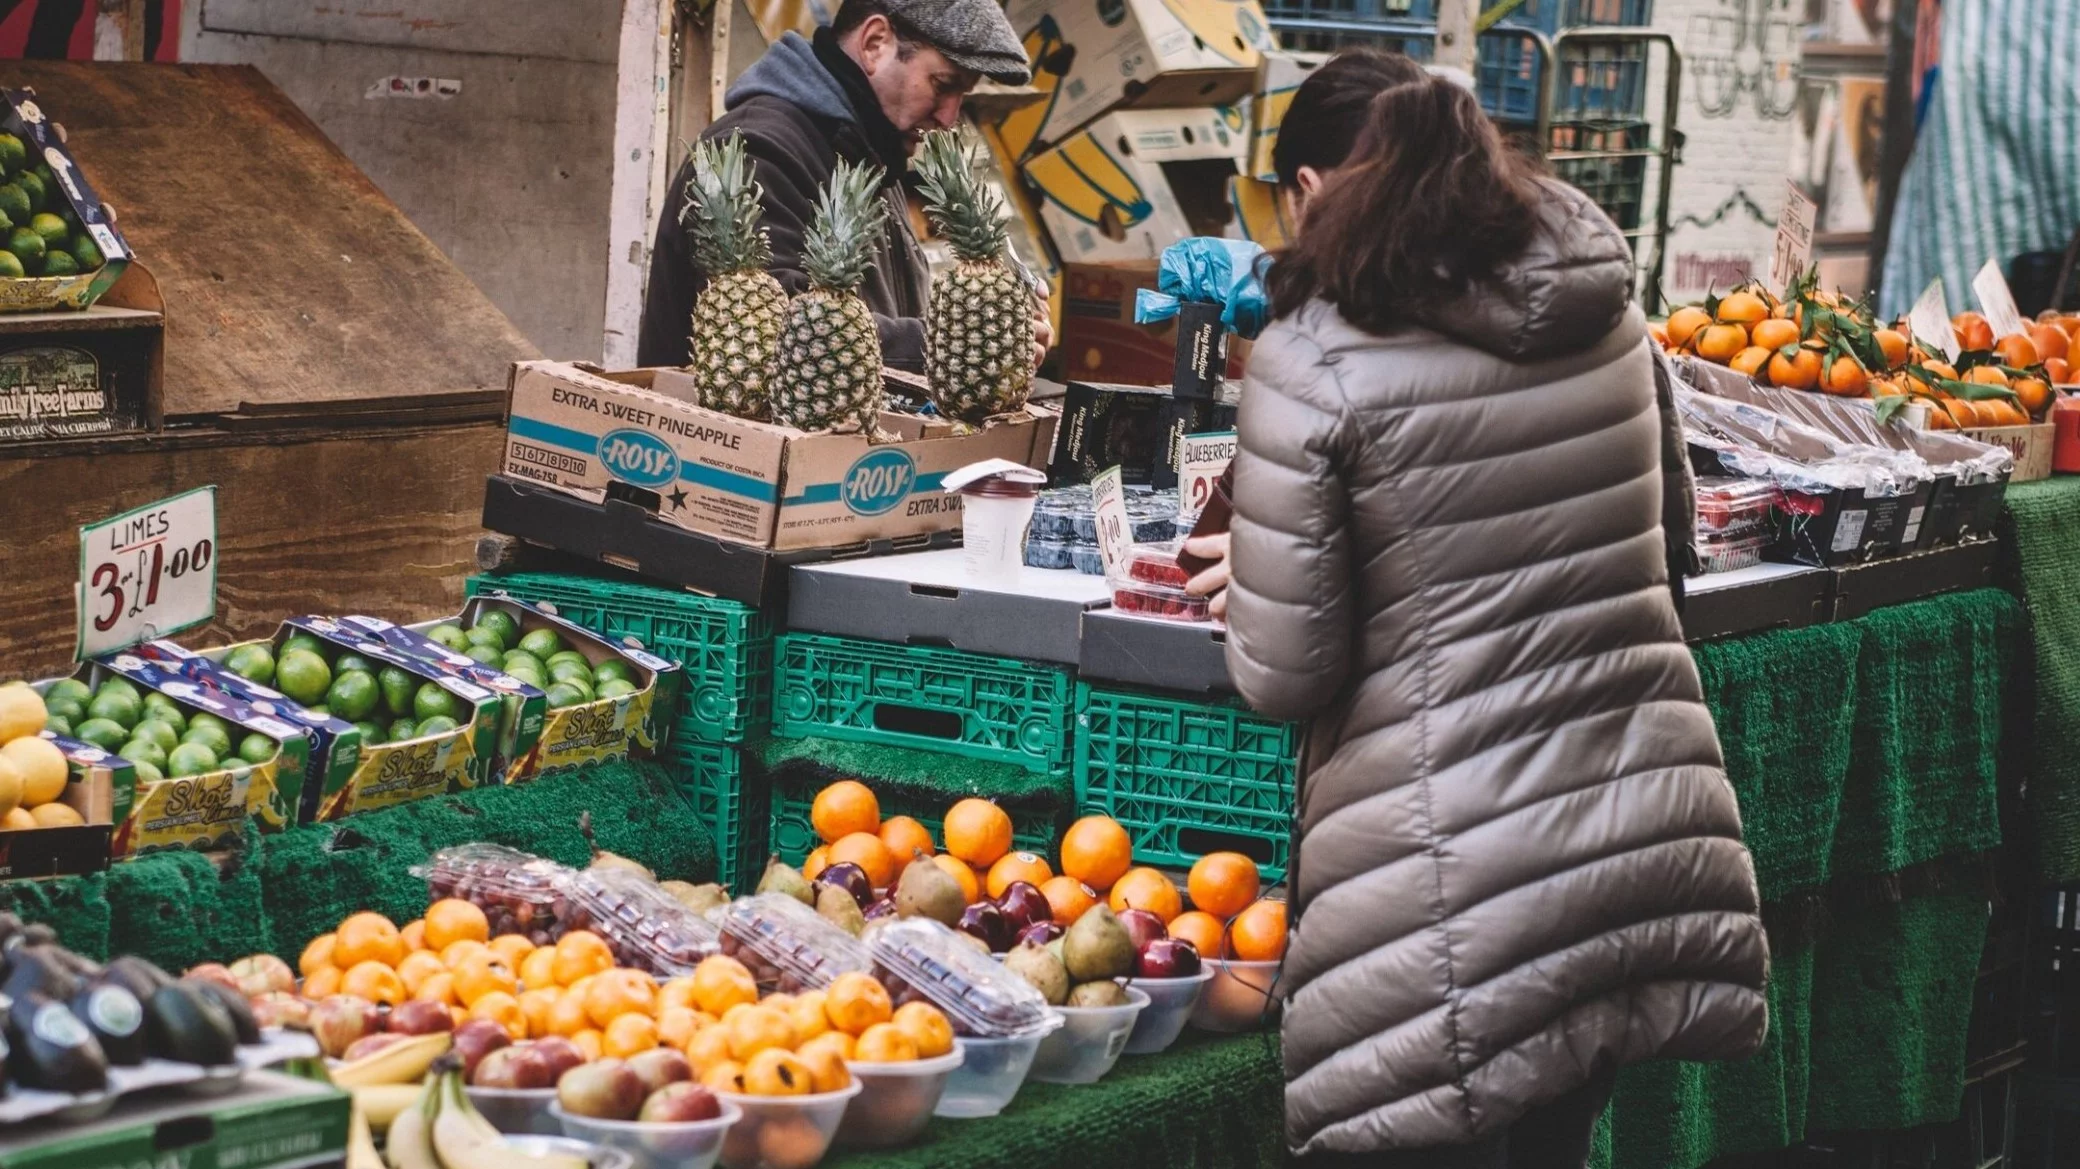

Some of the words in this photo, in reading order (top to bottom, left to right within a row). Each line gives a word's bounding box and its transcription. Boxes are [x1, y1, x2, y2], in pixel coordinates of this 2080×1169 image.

[1200, 323, 1212, 344] King
[1198, 344, 1211, 380] Medjoul
[552, 387, 598, 413] EXTRA
[603, 402, 655, 427] SWEET
[658, 416, 742, 450] PINEAPPLE
[1076, 406, 1087, 427] King
[606, 437, 671, 477] ROSY
[700, 456, 724, 468] PRODUCT
[725, 461, 734, 470] OF
[1071, 427, 1085, 462] Medjoul
[572, 458, 584, 473] 10
[849, 464, 909, 502] ROSY
[906, 498, 940, 517] EXTRA
[111, 510, 170, 550] LIMES
[92, 562, 125, 631] 3
[565, 700, 617, 740] Shot
[379, 741, 439, 782] Shot
[166, 773, 233, 817] Shot
